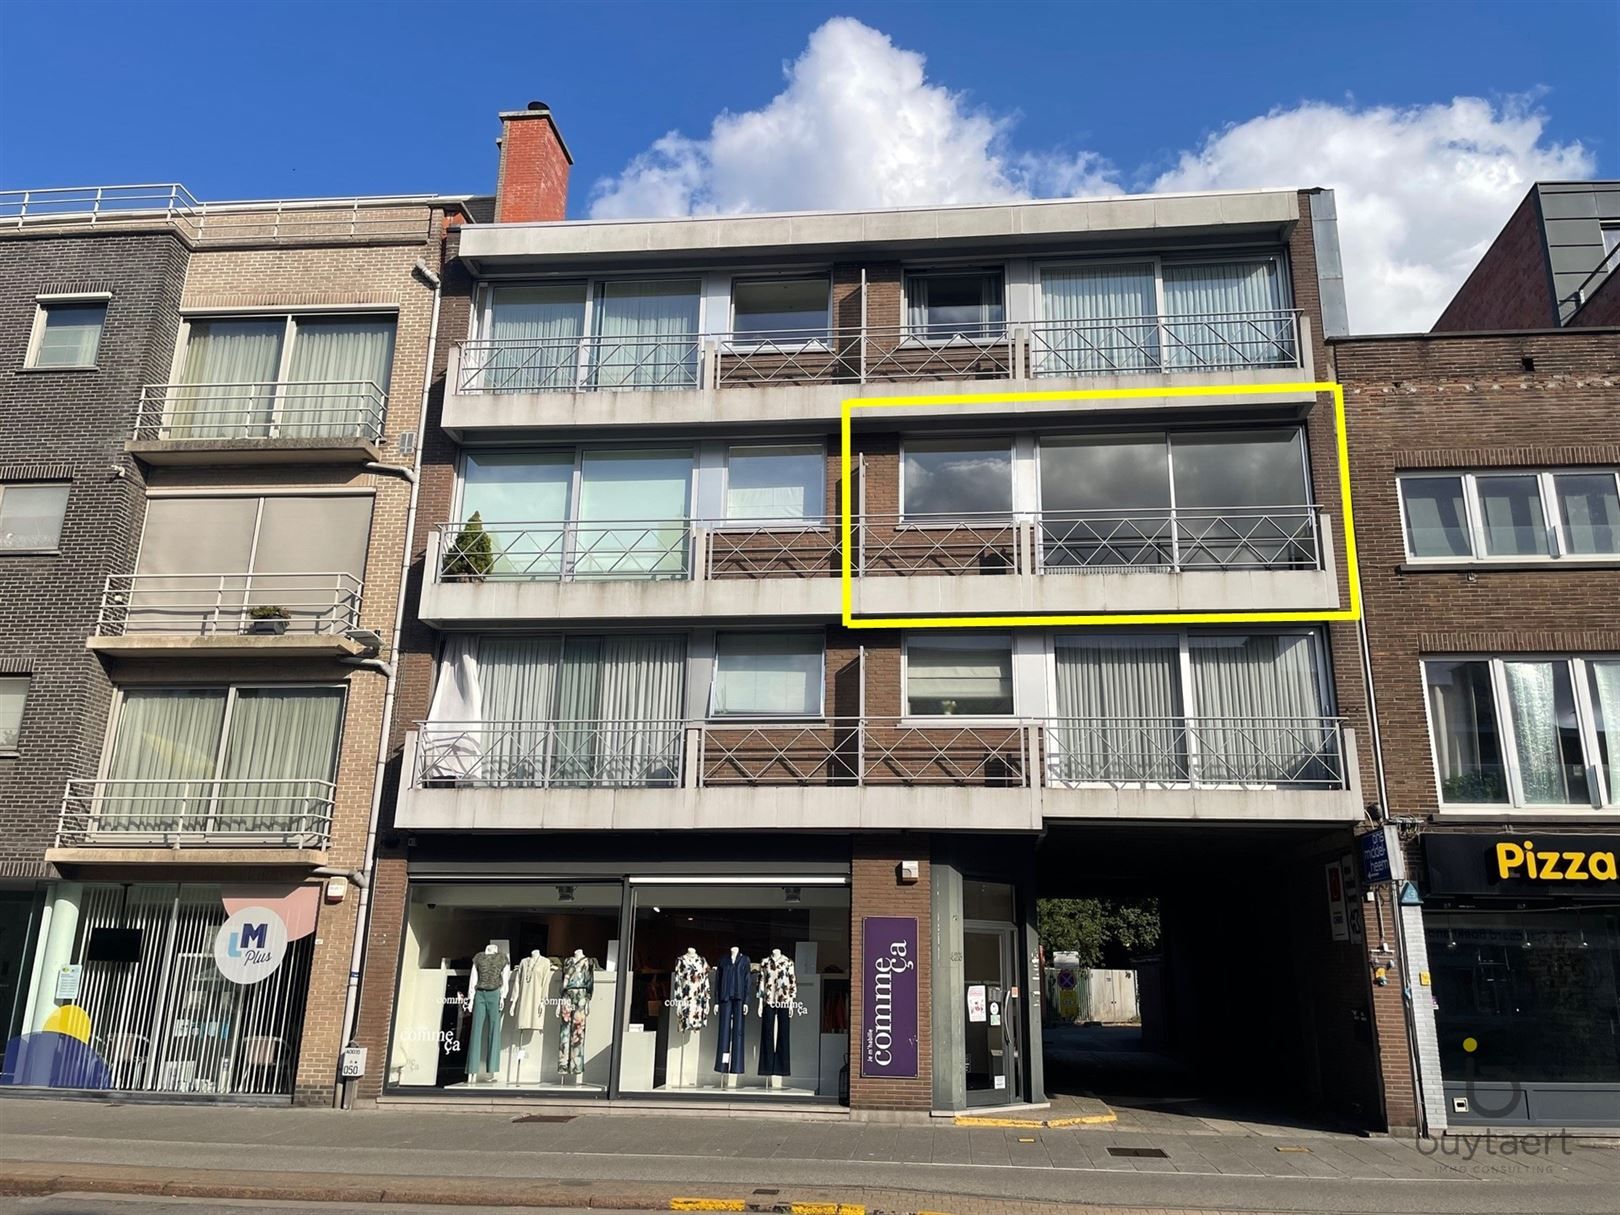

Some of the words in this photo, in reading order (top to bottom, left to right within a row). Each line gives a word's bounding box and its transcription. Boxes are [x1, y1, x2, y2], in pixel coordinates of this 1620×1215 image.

[1496, 840, 1617, 880] Pizza
[244, 950, 272, 966] Plus
[890, 939, 914, 973] ça
[769, 1000, 804, 1009] comme
[797, 1006, 808, 1016] ça
[875, 957, 892, 1067] comme
[400, 1030, 454, 1042] comme
[444, 1040, 461, 1055] ça
[343, 1065, 359, 1075] 050
